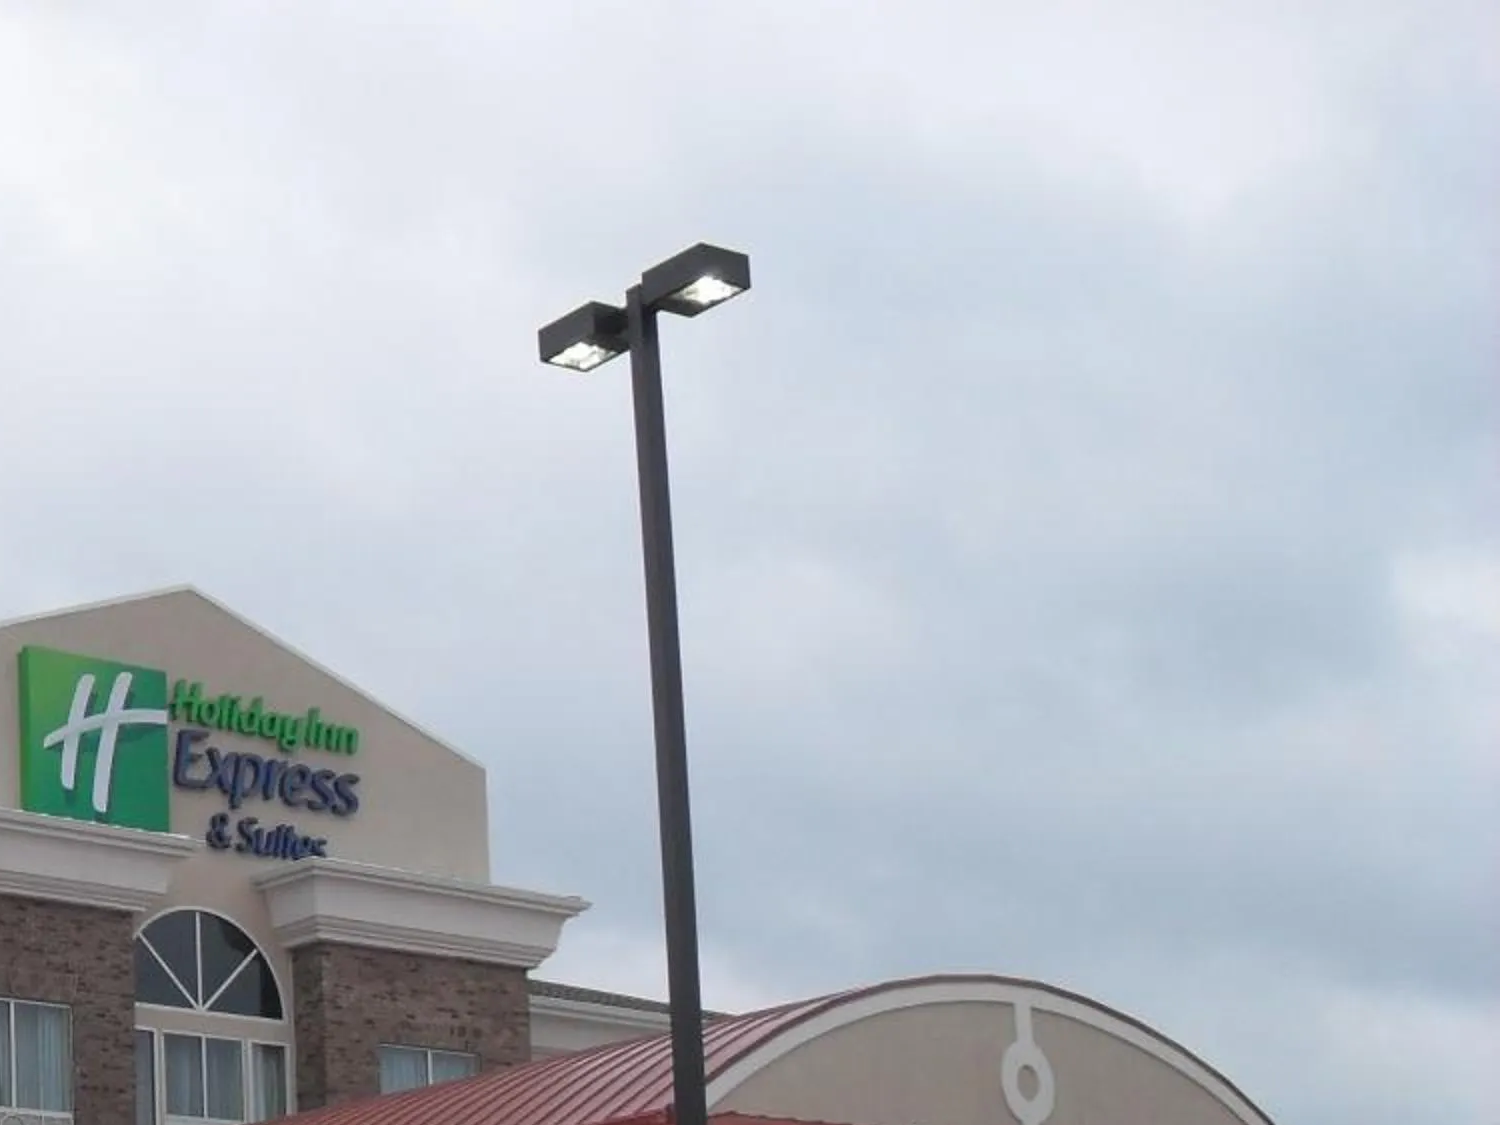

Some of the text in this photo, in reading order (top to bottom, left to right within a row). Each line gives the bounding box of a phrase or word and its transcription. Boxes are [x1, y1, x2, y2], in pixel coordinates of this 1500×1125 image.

[170, 679, 360, 756] Holiday Inn
[172, 728, 361, 817] Express
[206, 812, 328, 860] & Suites
